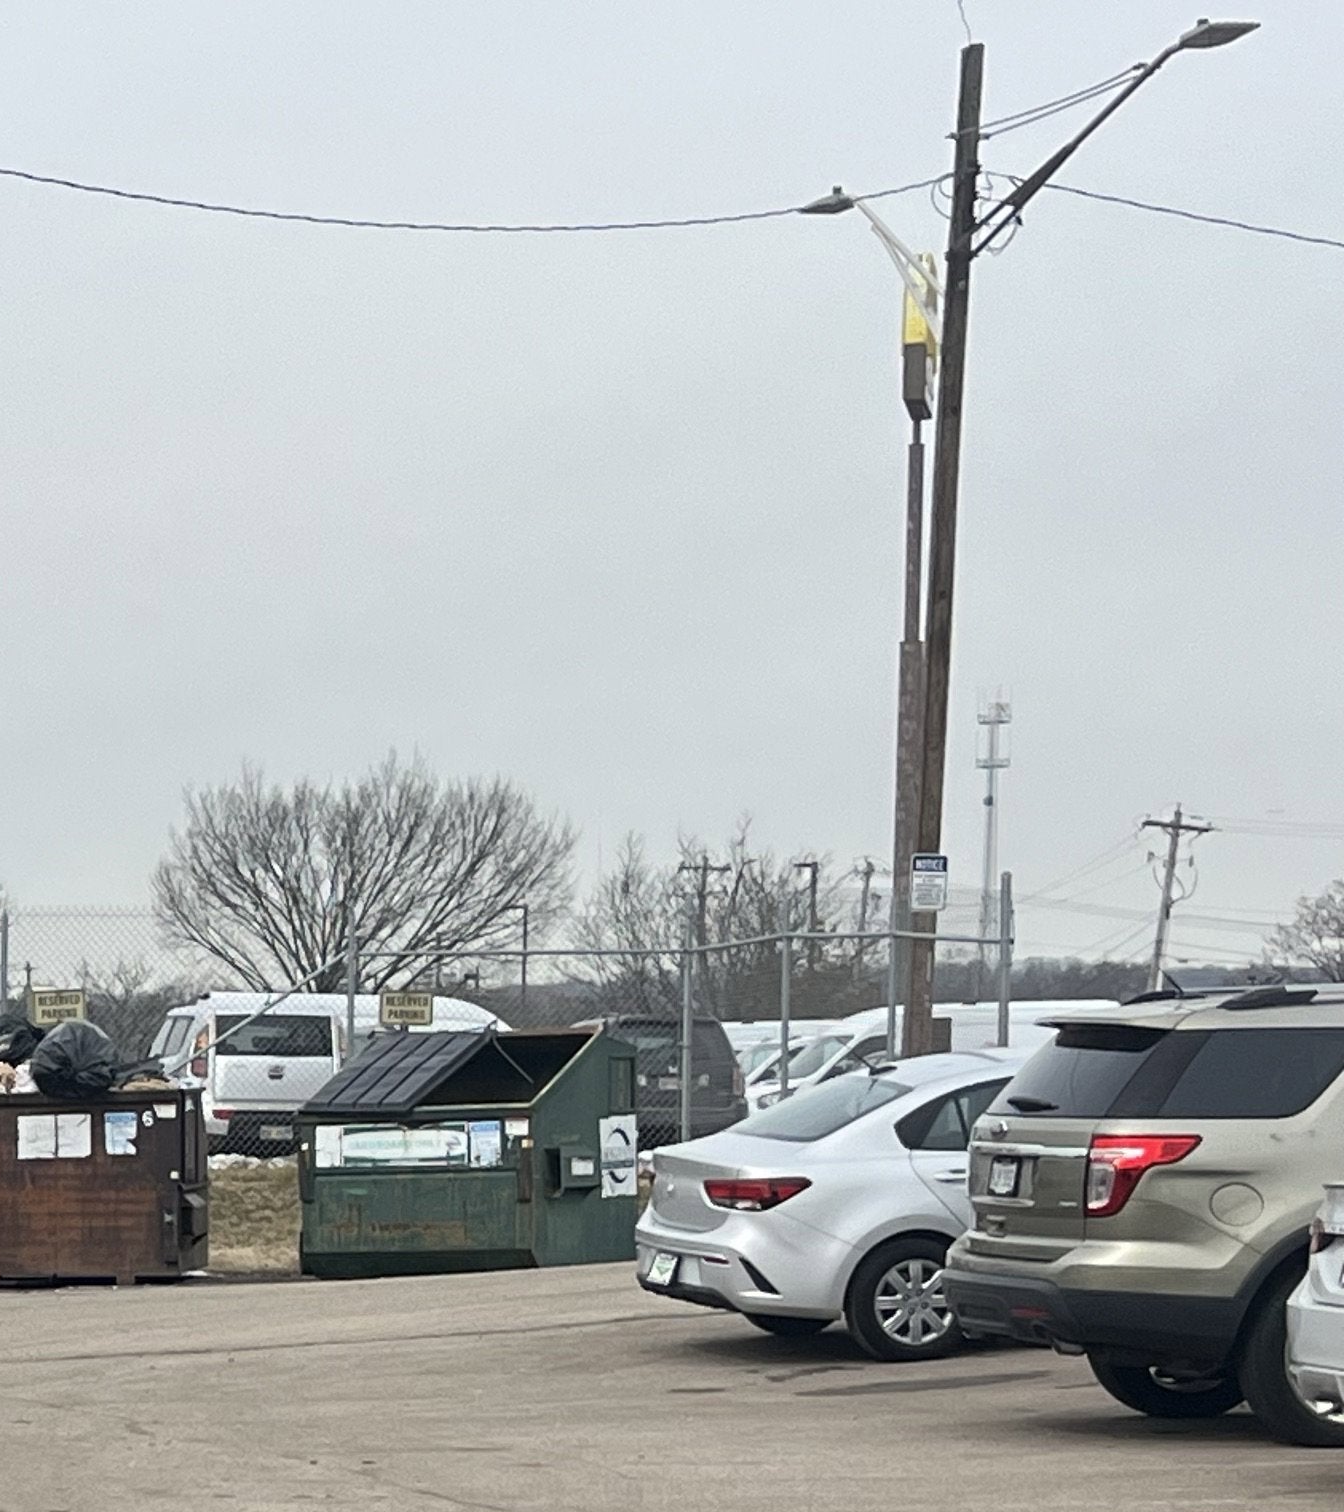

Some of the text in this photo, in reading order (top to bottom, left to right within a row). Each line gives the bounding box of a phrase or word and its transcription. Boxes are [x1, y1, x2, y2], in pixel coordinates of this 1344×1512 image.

[38, 994, 81, 1006] RESERVED
[385, 995, 429, 1007] RESERVED
[40, 1008, 77, 1019] PARKING
[387, 1008, 426, 1020] PARKING
